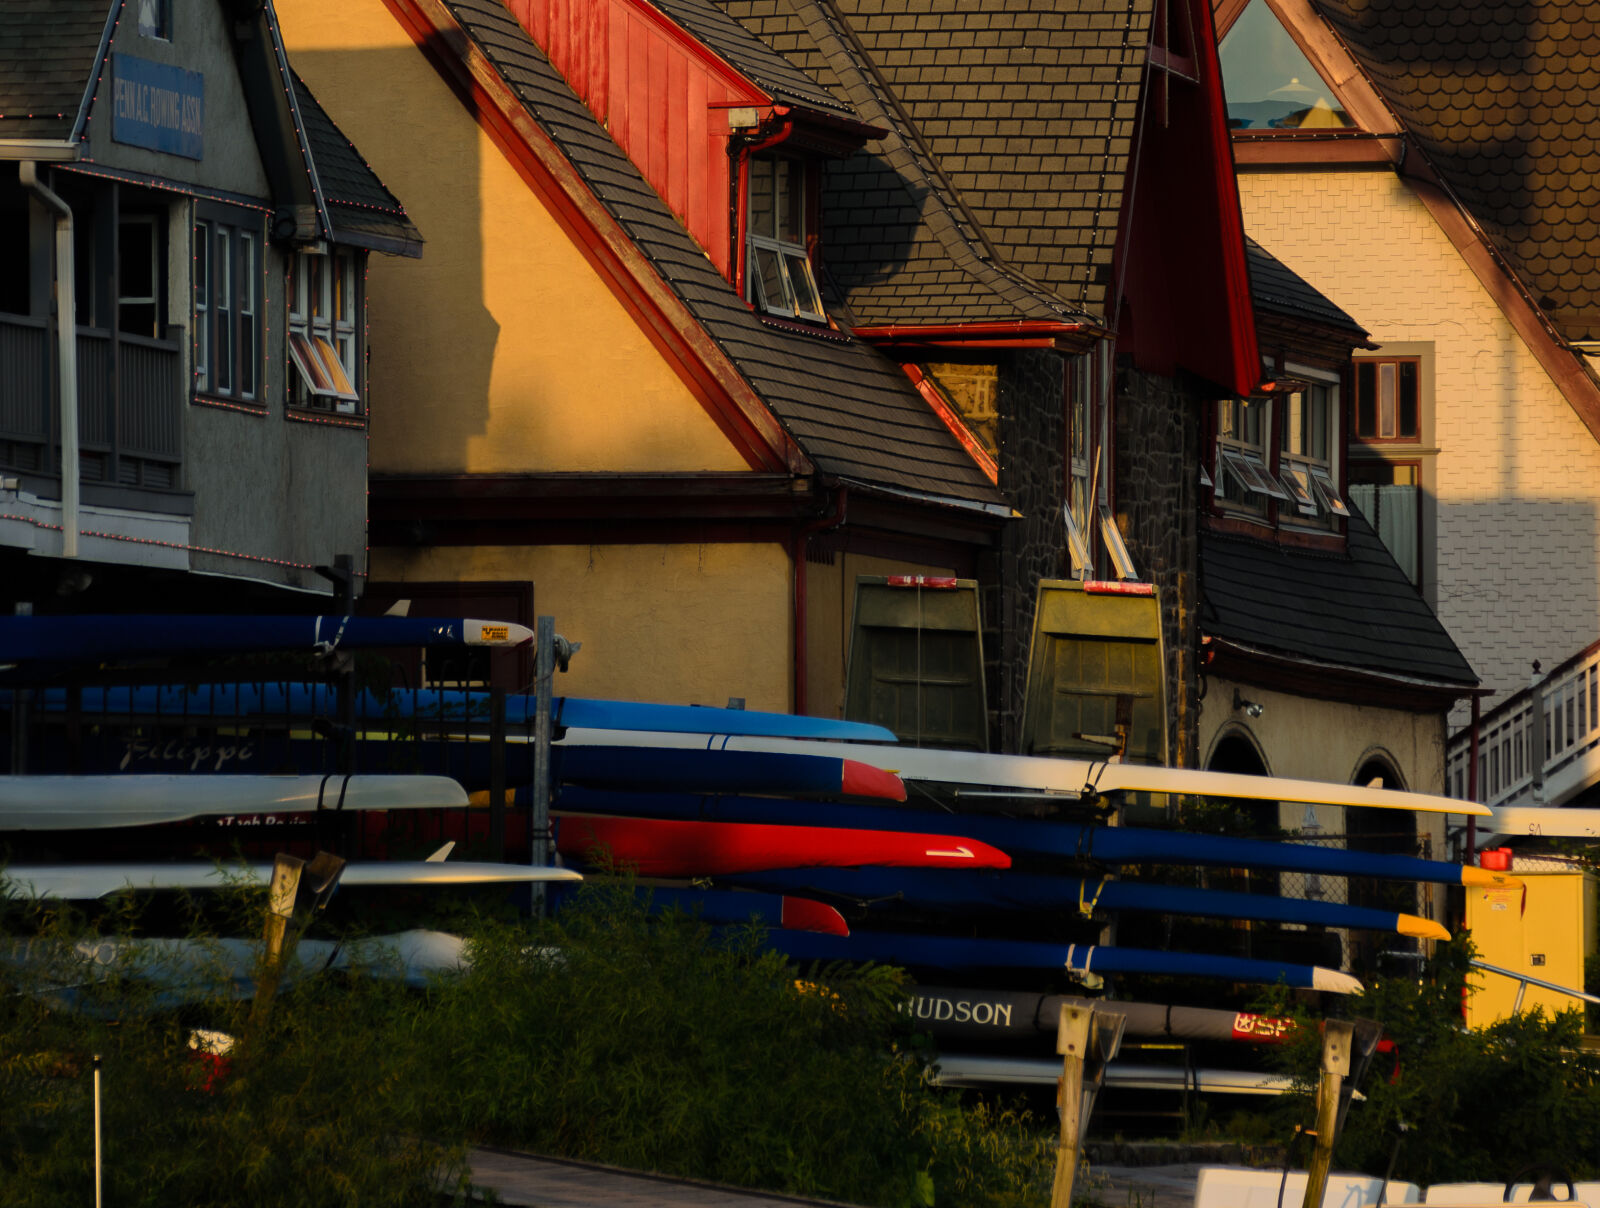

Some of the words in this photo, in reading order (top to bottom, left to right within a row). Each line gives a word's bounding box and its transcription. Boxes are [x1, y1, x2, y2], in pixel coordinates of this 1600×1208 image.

[114, 77, 135, 120] PENN
[150, 86, 180, 129] ROWING
[119, 737, 256, 772] Filippi
